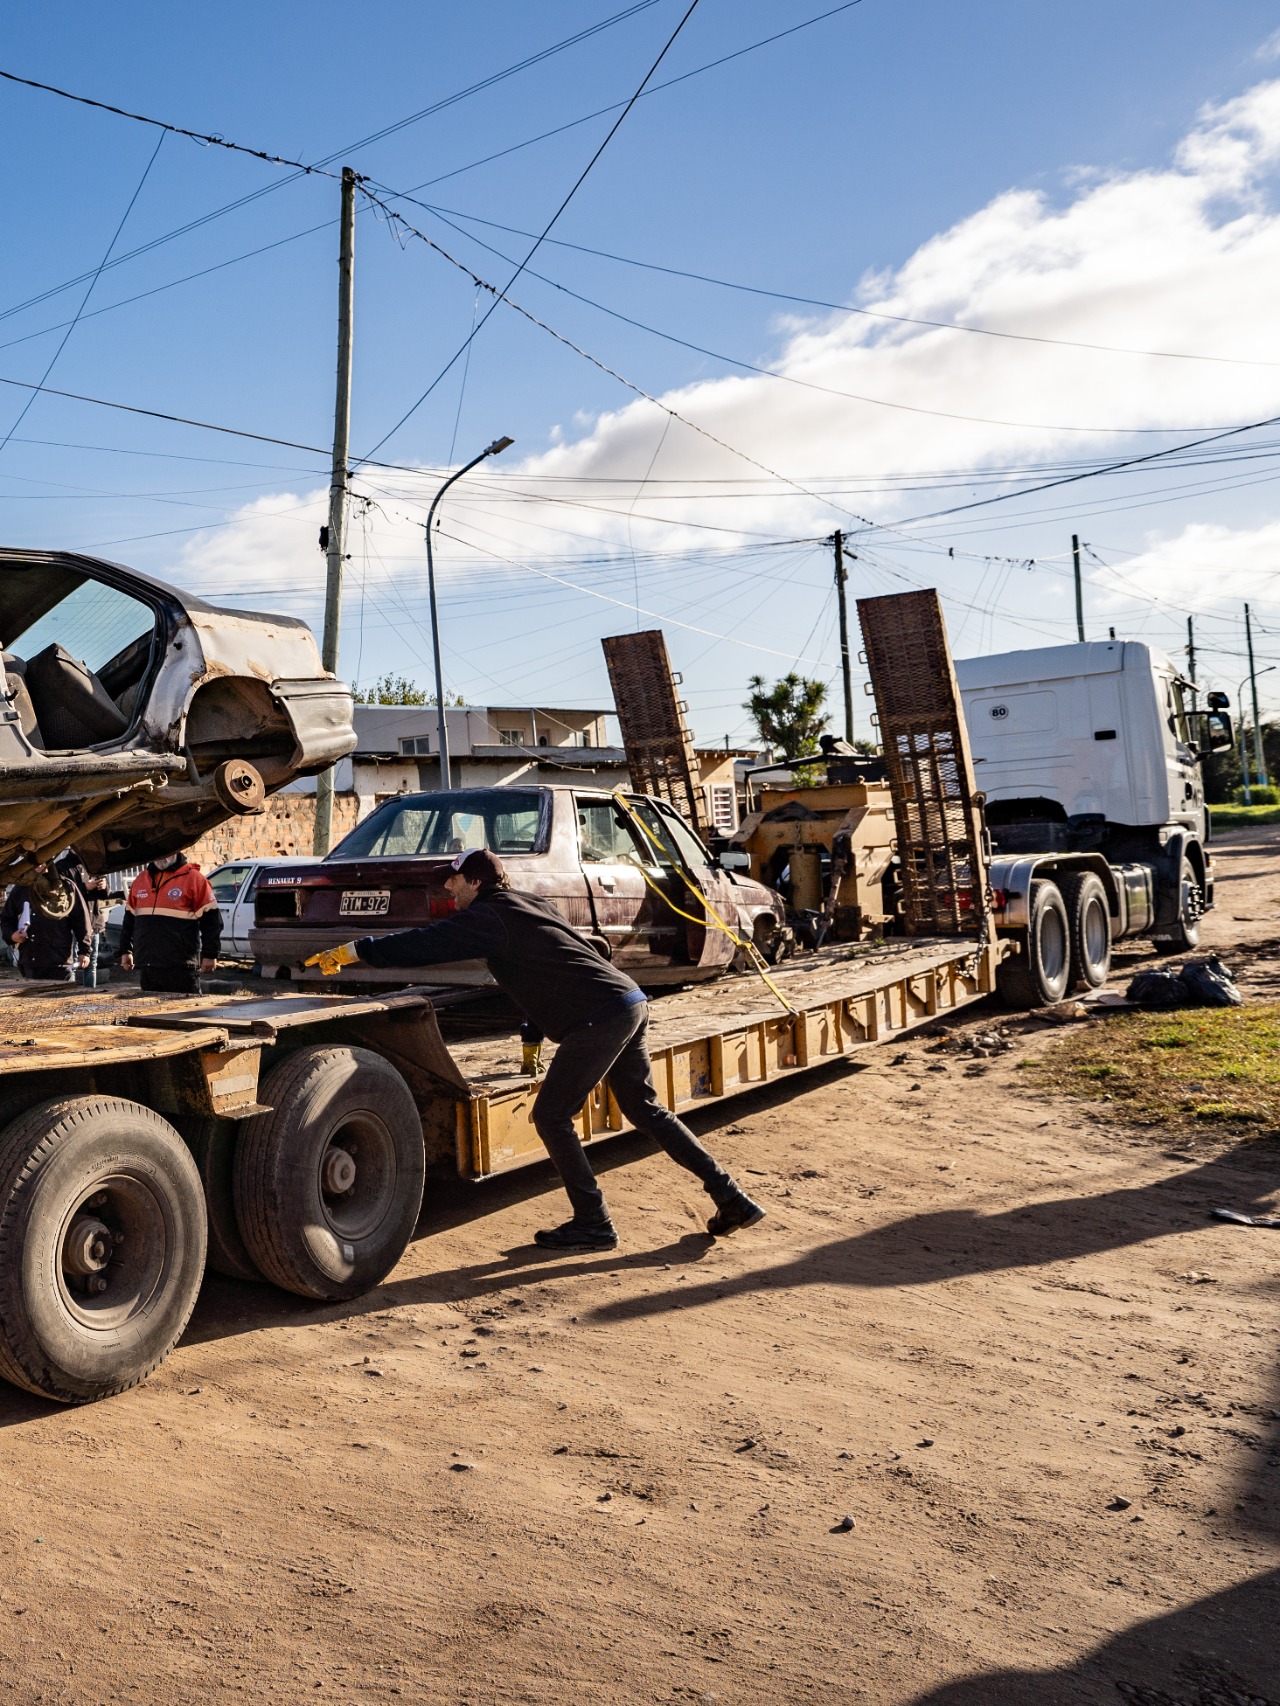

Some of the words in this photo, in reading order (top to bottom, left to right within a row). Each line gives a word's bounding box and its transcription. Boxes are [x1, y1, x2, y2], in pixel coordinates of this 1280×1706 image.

[992, 708, 1006, 717] 80
[297, 877, 302, 885] 9
[341, 897, 363, 910] RTM
[367, 897, 388, 910] 972
